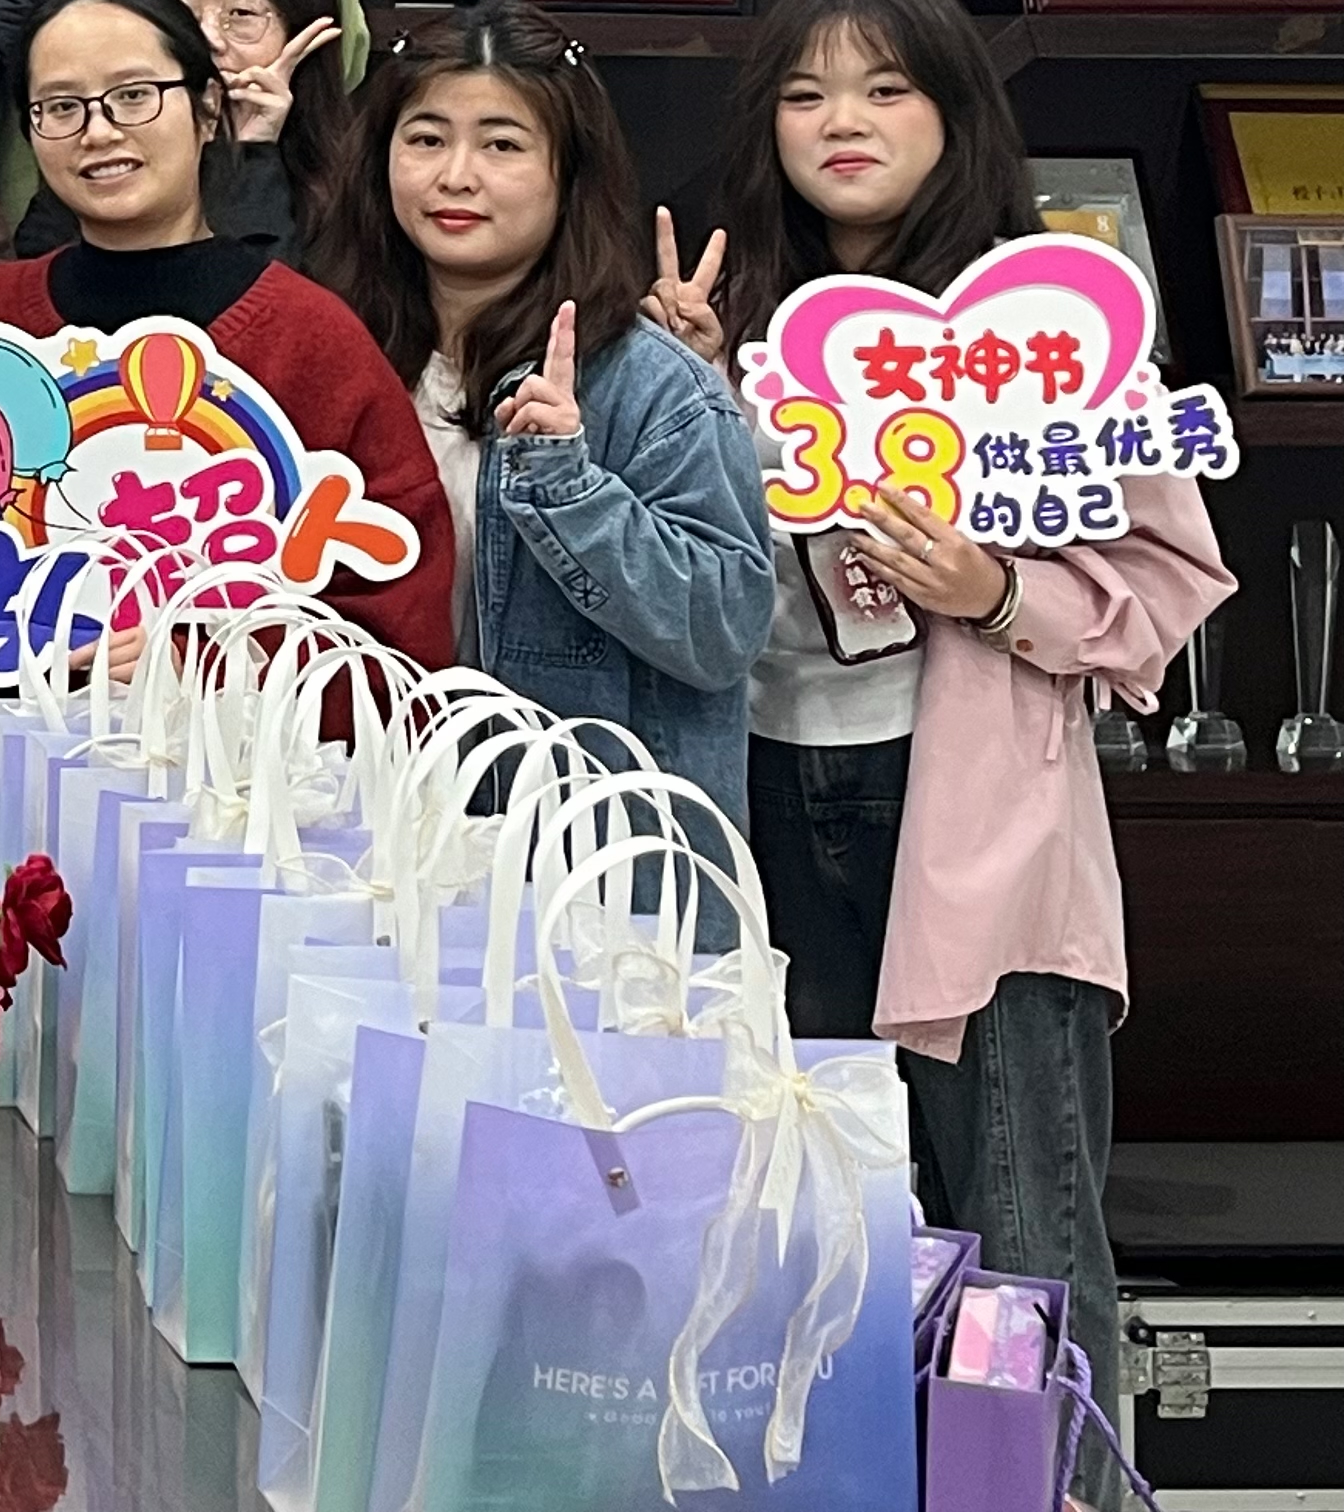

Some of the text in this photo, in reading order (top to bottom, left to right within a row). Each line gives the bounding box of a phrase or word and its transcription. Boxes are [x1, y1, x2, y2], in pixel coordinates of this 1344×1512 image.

[853, 327, 1085, 404] 女神节
[764, 396, 967, 524] 3.8
[972, 393, 1229, 478] 做最优秀
[969, 485, 1120, 537] 的自己
[533, 1362, 630, 1401] HERE'S
[636, 1377, 658, 1402] A
[726, 1361, 776, 1394] FOR
